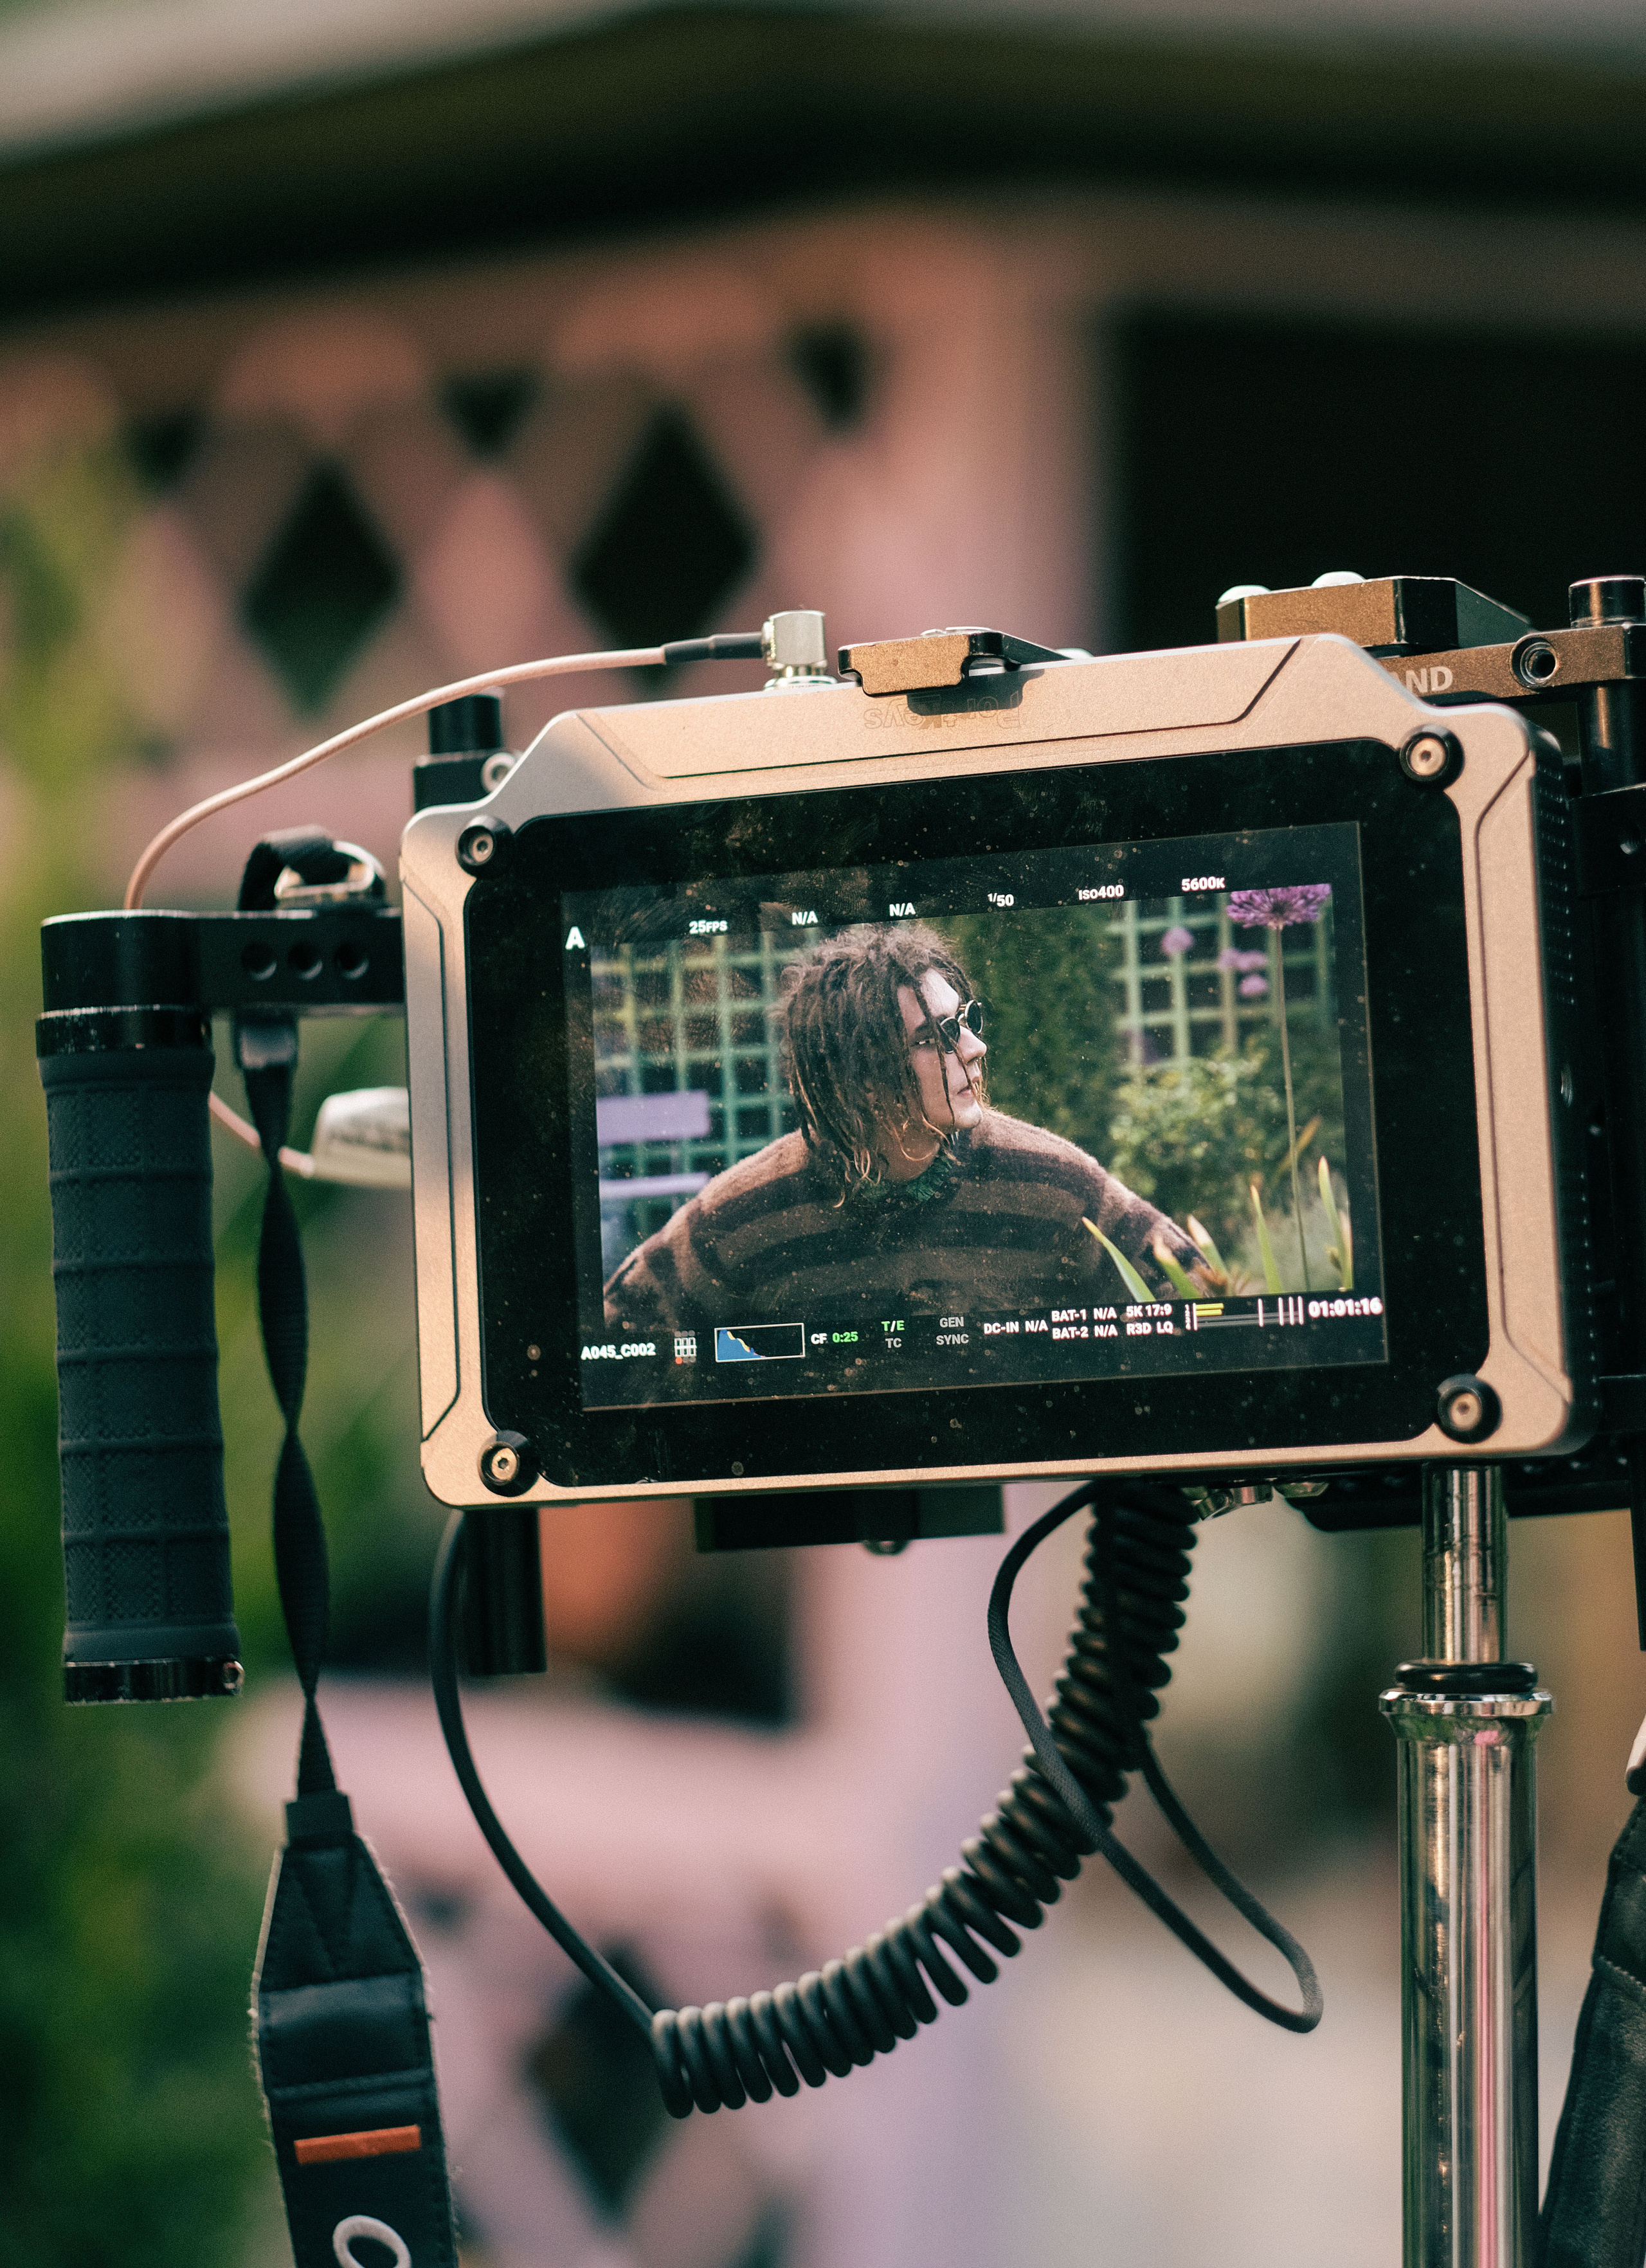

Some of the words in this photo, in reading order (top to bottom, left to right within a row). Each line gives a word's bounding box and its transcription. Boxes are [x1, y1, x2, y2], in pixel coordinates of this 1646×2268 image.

[1388, 666, 1453, 694] ND
[1182, 876, 1225, 892] 5600K
[988, 893, 1014, 907] 1/50
[1078, 885, 1124, 901] ISO400
[791, 910, 818, 925] N/A
[889, 903, 918, 917] N/A
[689, 920, 728, 934] 25FPS
[566, 926, 585, 950] A
[1051, 1309, 1087, 1322] BAT-1
[1093, 1307, 1117, 1320] N/A
[1126, 1305, 1143, 1317] 5K
[1145, 1304, 1172, 1317] 17:9
[1308, 1297, 1383, 1318] 01:01:16
[882, 1320, 905, 1332] T/E
[939, 1317, 964, 1328] GEN
[983, 1321, 1019, 1335] DC-IN
[1025, 1320, 1049, 1333] N/A
[1126, 1322, 1152, 1336] R3D
[1156, 1320, 1175, 1334] LQ
[811, 1333, 828, 1344] CF
[833, 1331, 858, 1343] 0:25
[936, 1334, 969, 1345] SYNC
[1052, 1326, 1089, 1340] BAT-2
[1094, 1324, 1118, 1338] N/A
[885, 1338, 901, 1348] TC
[581, 1342, 656, 1360] A045_C002
